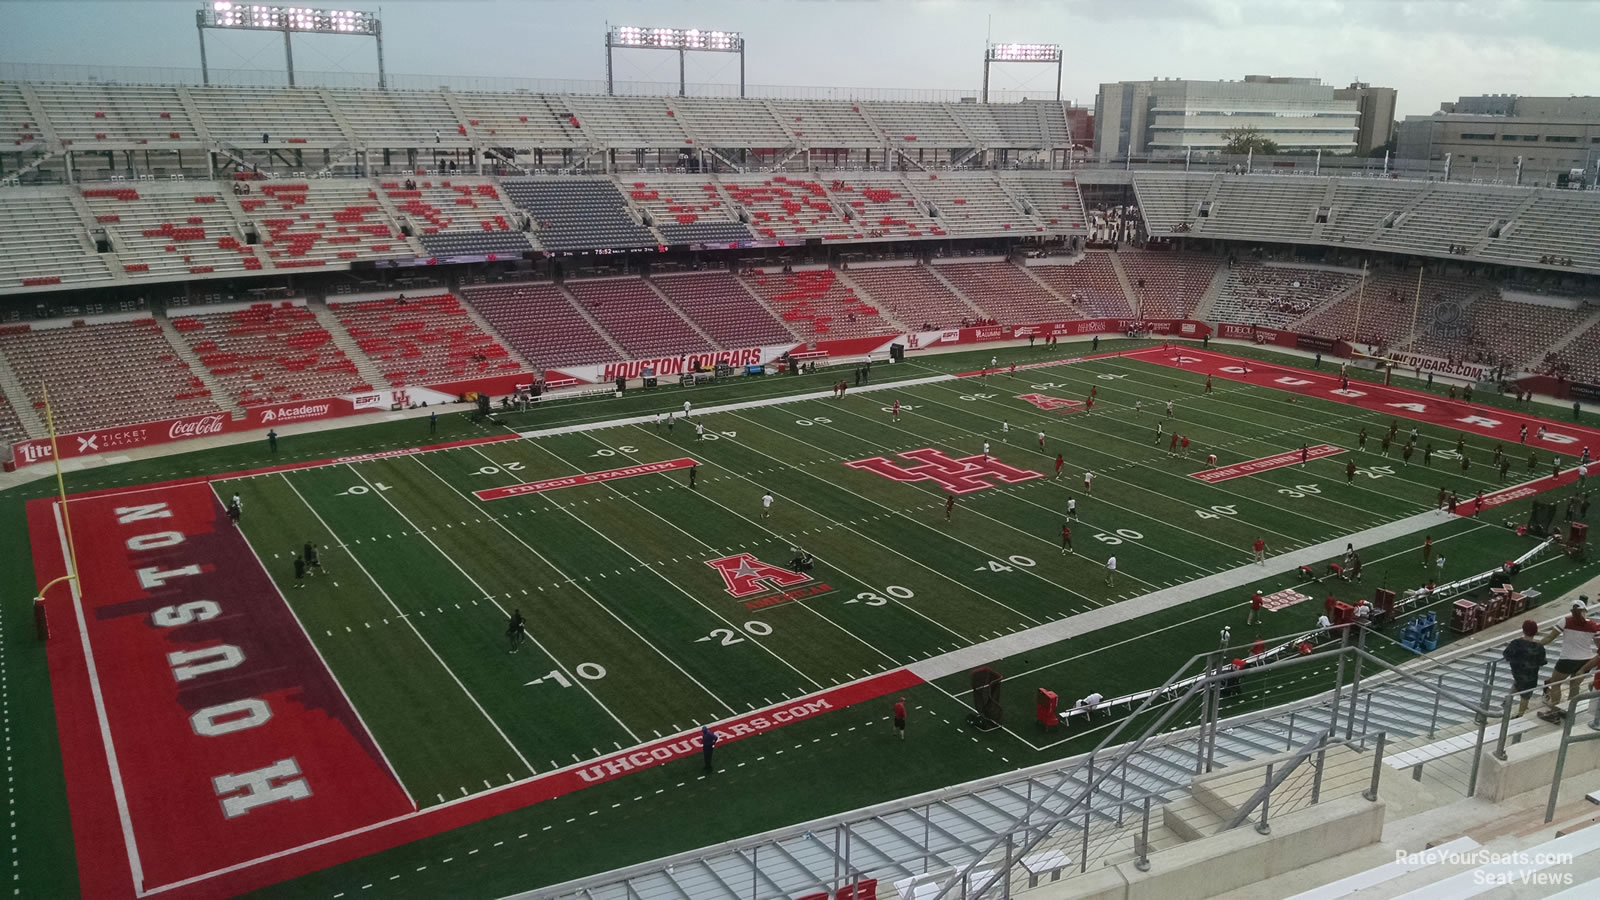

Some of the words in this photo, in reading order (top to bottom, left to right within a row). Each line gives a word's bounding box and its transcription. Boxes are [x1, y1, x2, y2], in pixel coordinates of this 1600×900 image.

[942, 331, 959, 339] ESPN
[1424, 324, 1469, 338] Allstate
[603, 357, 684, 382] HOUSTON
[687, 348, 762, 373] COUGARS
[355, 395, 381, 404] ESPN
[278, 403, 329, 418] Academy
[101, 429, 147, 442] TICKET
[168, 414, 225, 439] Coca-Cola
[103, 436, 147, 447] GALAXY
[18, 443, 53, 463] Lite
[502, 478, 575, 495] TDECU
[583, 461, 677, 482] STADIUM
[1278, 484, 1321, 498] 30
[1195, 505, 1238, 520] 40
[1093, 528, 1144, 546] 50
[985, 554, 1037, 575] 40
[744, 583, 834, 611] AMERICAN
[857, 585, 915, 607] 30
[709, 620, 773, 647] 20
[114, 502, 313, 819] HOUSTON
[543, 662, 607, 689] 10
